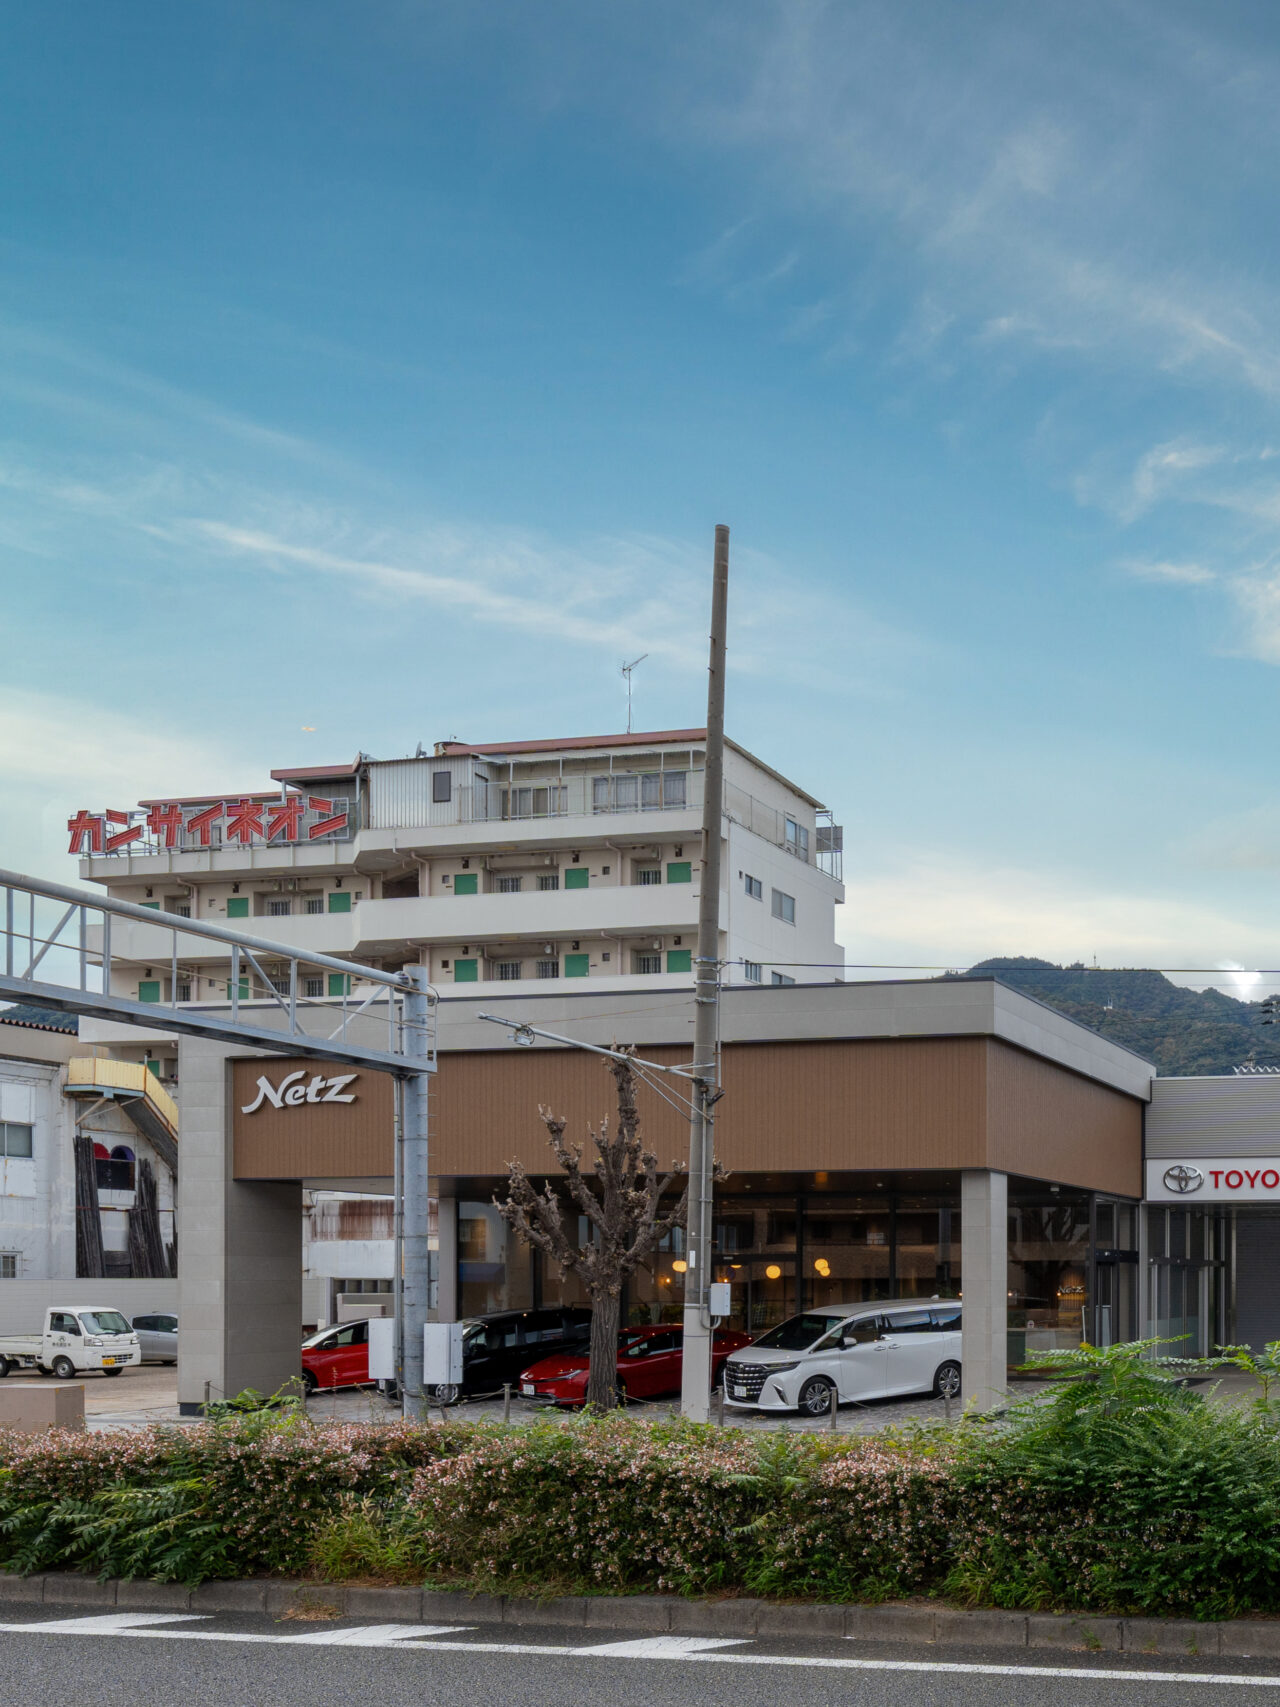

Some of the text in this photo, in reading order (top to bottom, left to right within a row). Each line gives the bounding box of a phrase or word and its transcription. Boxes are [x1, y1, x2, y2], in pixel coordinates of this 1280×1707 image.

[67, 795, 348, 854] カンサイネオン
[241, 1070, 358, 1114] Netz
